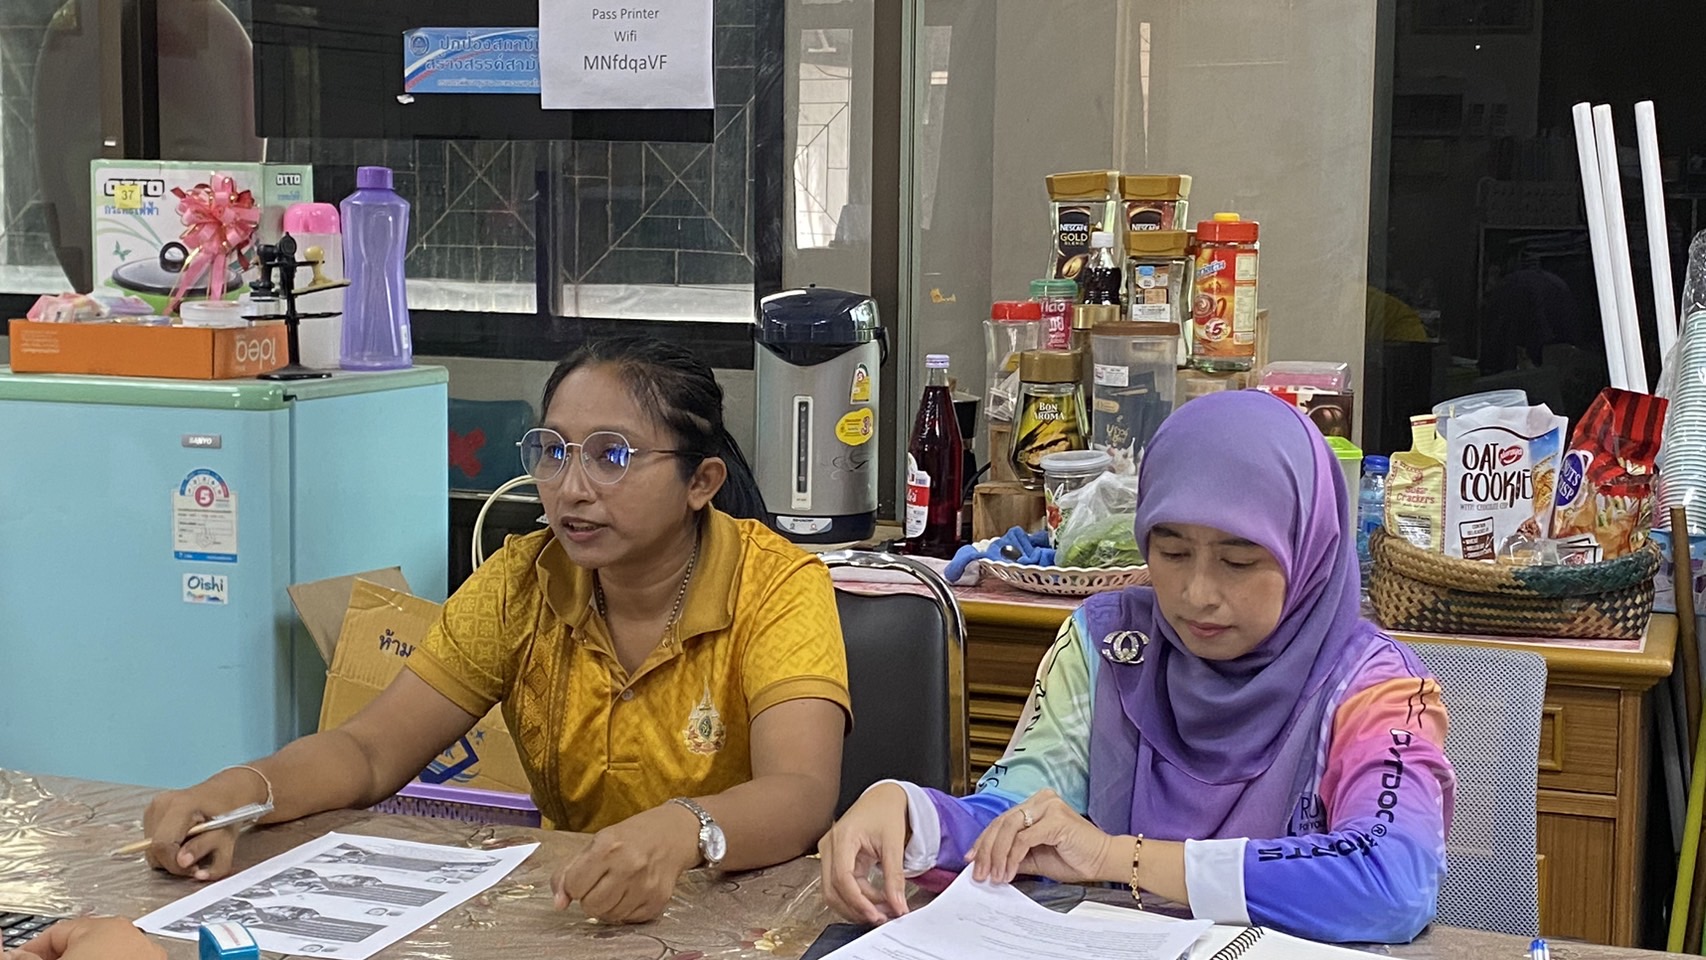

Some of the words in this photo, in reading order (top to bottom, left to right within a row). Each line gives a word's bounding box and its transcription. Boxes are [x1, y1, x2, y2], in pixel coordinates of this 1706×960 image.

[592, 8, 617, 20] Pass
[620, 8, 660, 20] Printer
[614, 30, 637, 42] Wifi
[583, 54, 668, 73] MNfdqaVF
[276, 173, 302, 186] OTTO
[121, 190, 134, 201] 37
[1060, 233, 1088, 242] GOLD
[236, 337, 277, 370] idea
[1039, 402, 1058, 412] BON
[1462, 443, 1499, 477] OAT
[187, 575, 224, 592] Oishi
